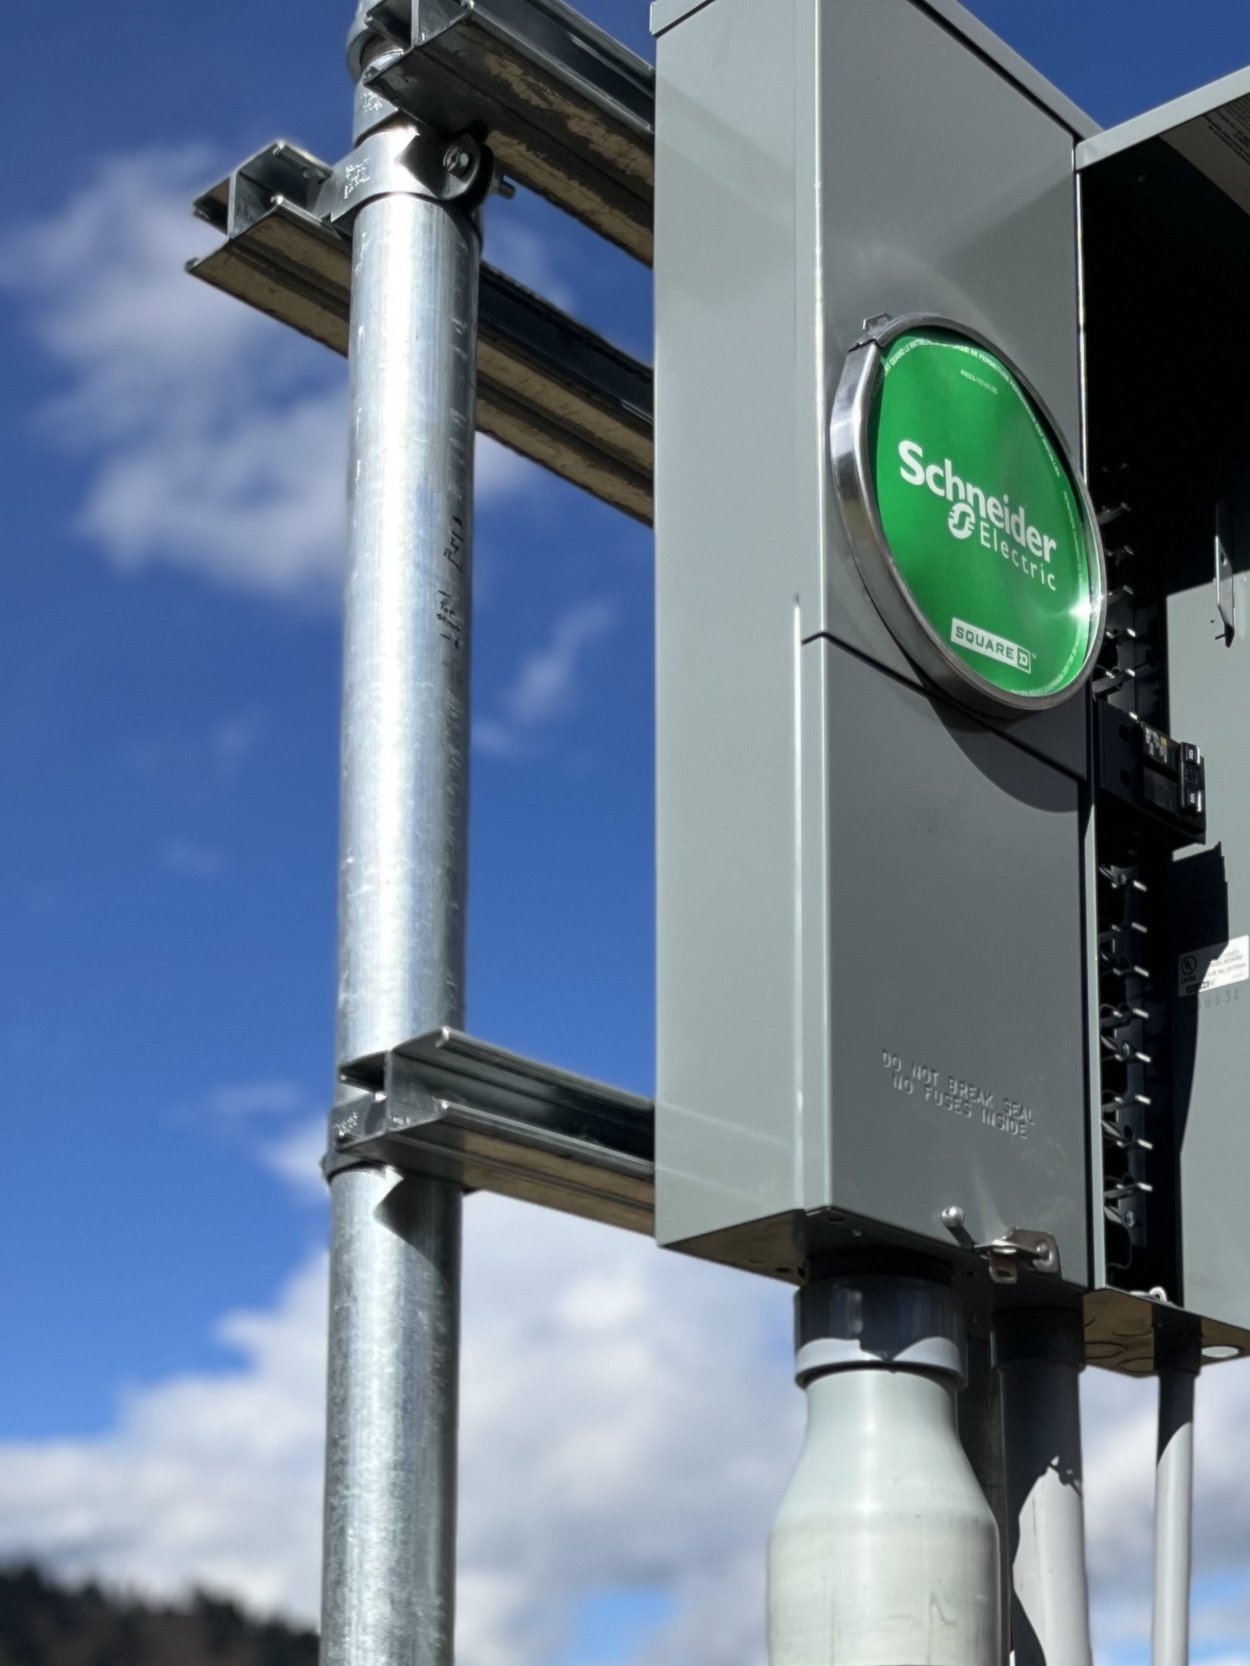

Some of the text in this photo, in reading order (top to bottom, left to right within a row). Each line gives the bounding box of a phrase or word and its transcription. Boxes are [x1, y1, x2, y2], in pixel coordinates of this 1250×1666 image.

[898, 440, 1057, 563] Schneider
[980, 520, 1056, 591] Electric
[955, 626, 1015, 660] SQUARE
[882, 1049, 1035, 1125] DO NOT BREAK SEAL
[892, 1073, 1028, 1139] NO FUSES INSIDE
